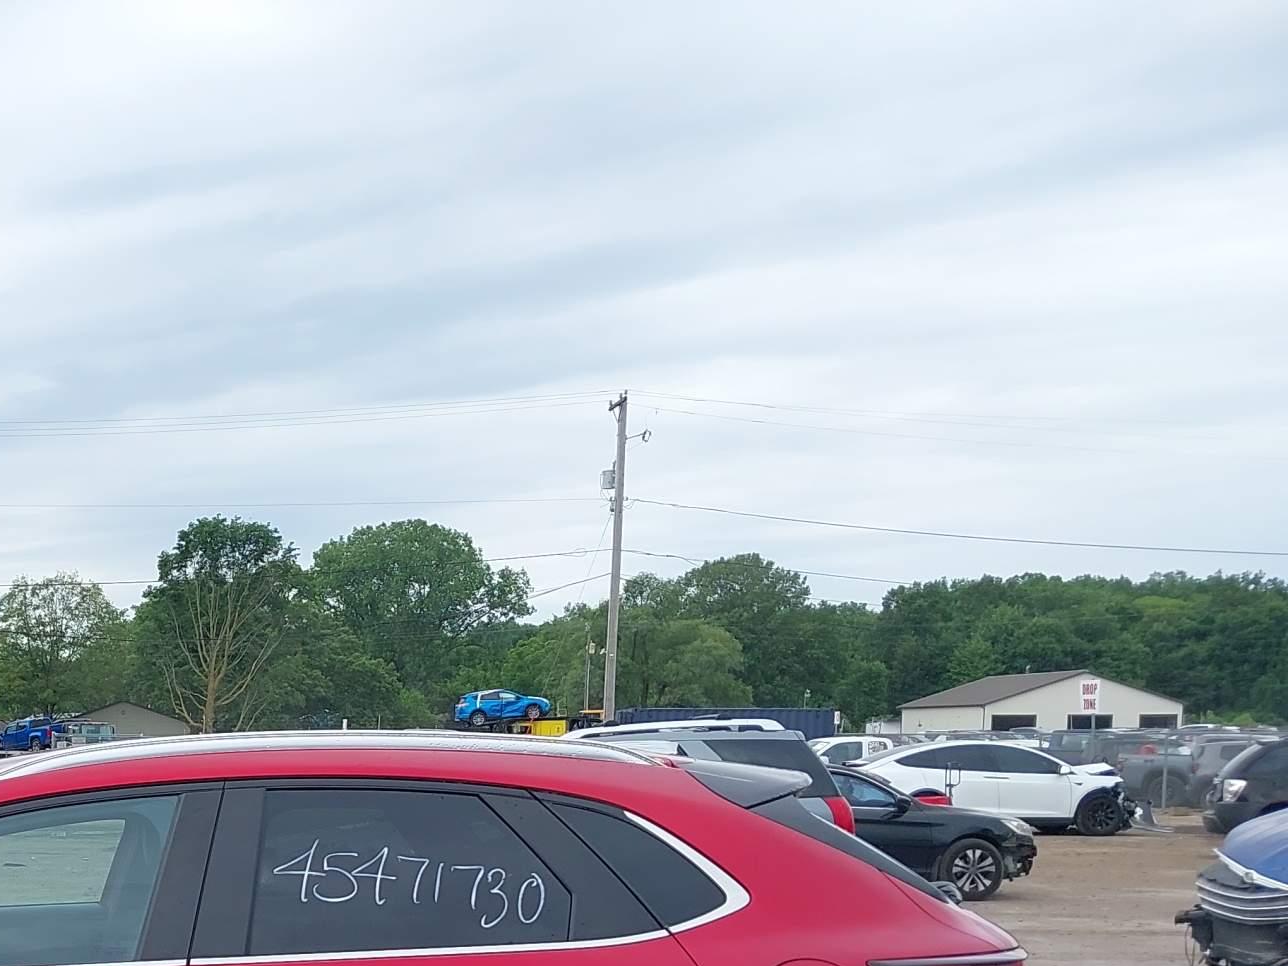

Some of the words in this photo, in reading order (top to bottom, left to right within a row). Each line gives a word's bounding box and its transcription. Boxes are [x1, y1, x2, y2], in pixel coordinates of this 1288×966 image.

[1082, 683, 1097, 695] DROP
[1083, 698, 1096, 710] ZONE
[273, 839, 545, 928] 45471730
